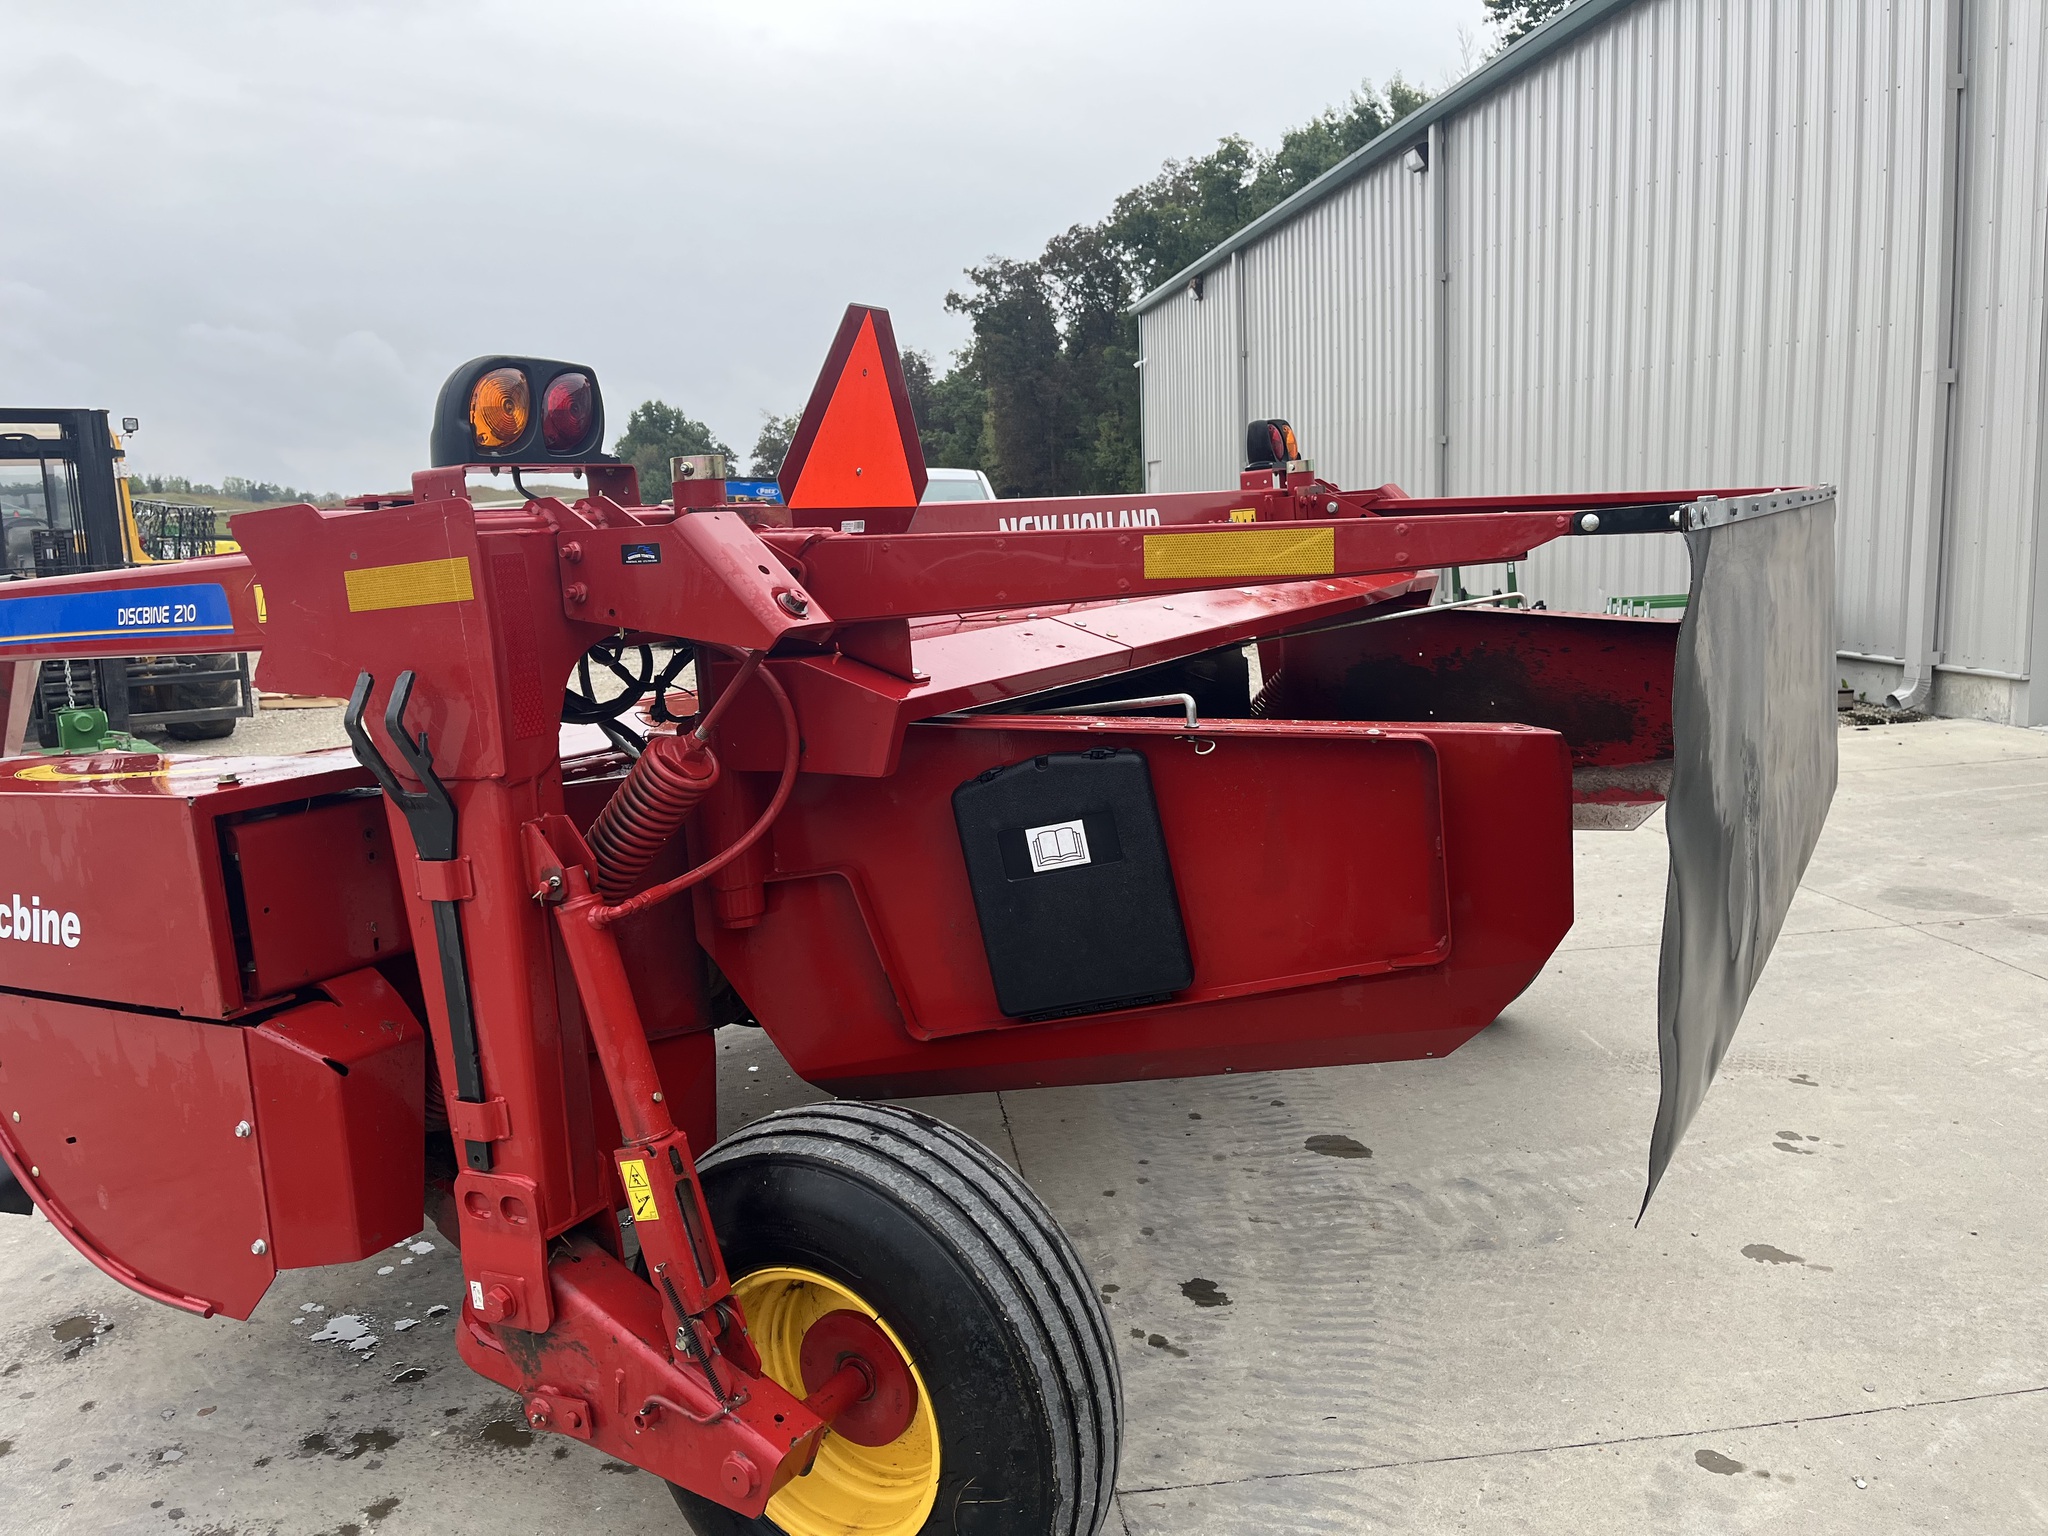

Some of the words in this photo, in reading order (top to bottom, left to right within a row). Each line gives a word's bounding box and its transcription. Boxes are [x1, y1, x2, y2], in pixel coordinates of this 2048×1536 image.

[117, 605, 170, 626] DISCBINE
[173, 603, 197, 623] 210
[0, 893, 81, 948] cbine
